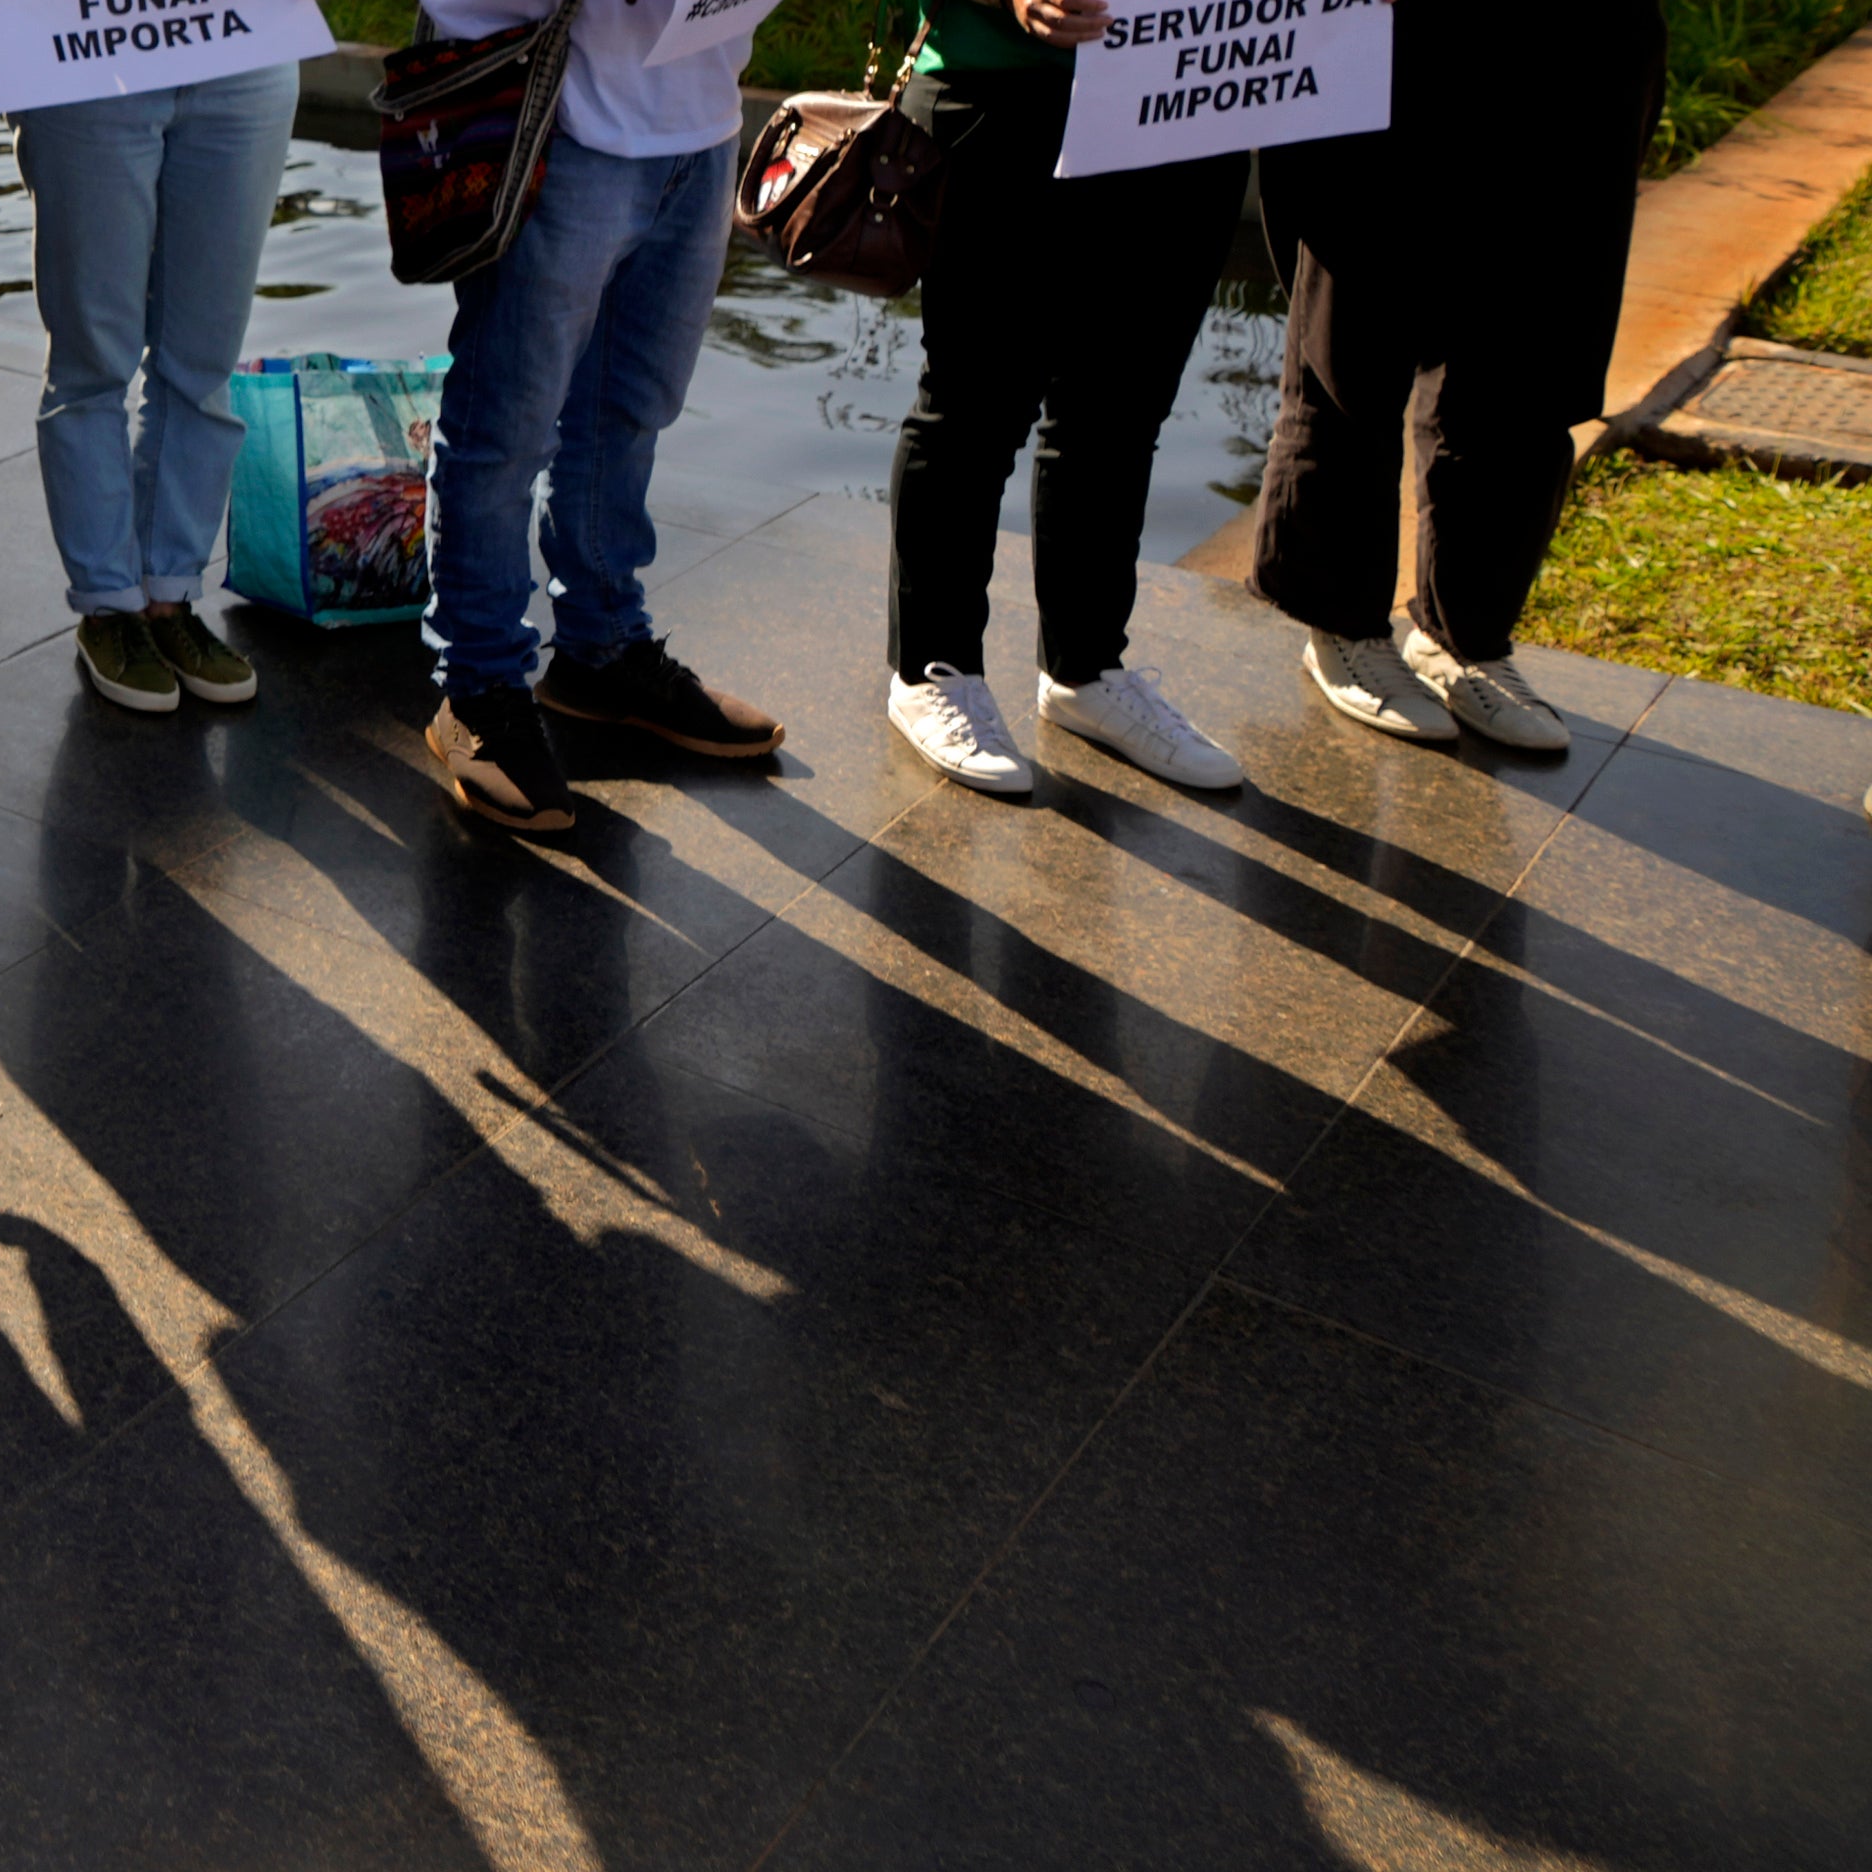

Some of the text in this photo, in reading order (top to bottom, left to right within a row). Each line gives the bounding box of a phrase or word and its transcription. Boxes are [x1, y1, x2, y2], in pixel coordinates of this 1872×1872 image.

[53, 9, 252, 63] IMPORTA
[1175, 30, 1296, 80] FUNAI
[1138, 66, 1318, 126] IMPORTA
